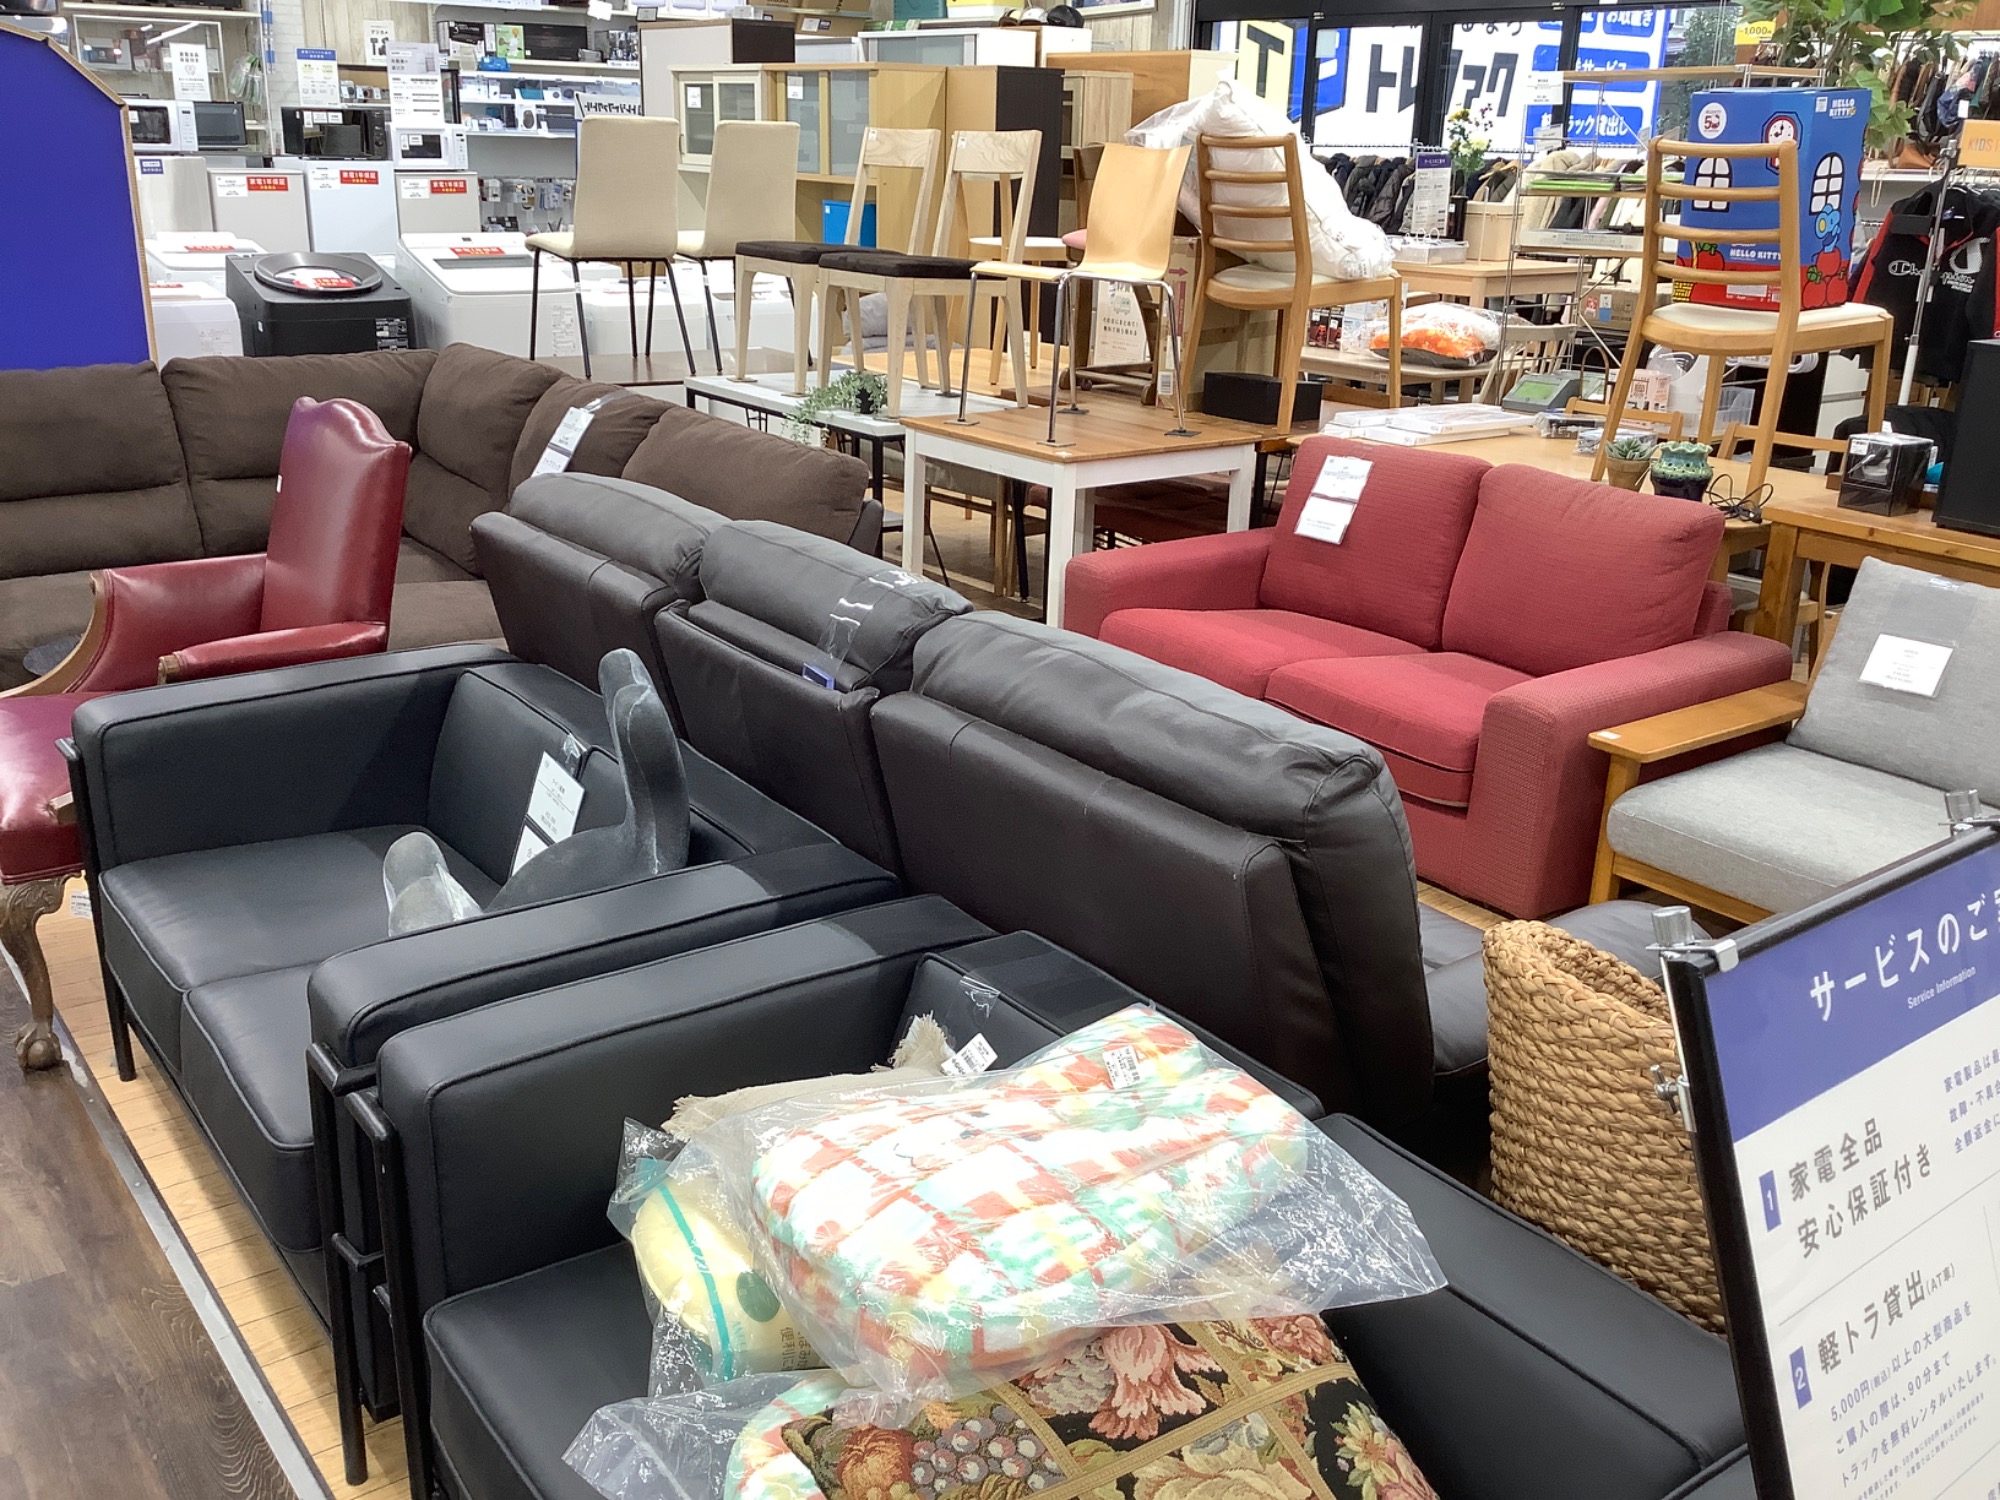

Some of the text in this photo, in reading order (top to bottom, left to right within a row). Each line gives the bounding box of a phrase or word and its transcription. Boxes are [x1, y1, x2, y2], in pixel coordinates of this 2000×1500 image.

[1729, 248, 1756, 258] HELLO
[1907, 966, 1976, 1010] Service Information
[1788, 1117, 1883, 1202] 家電全品
[1766, 1189, 1774, 1212] 1
[1797, 1143, 1931, 1259] 安心保証付き
[1795, 1366, 1807, 1391] 2
